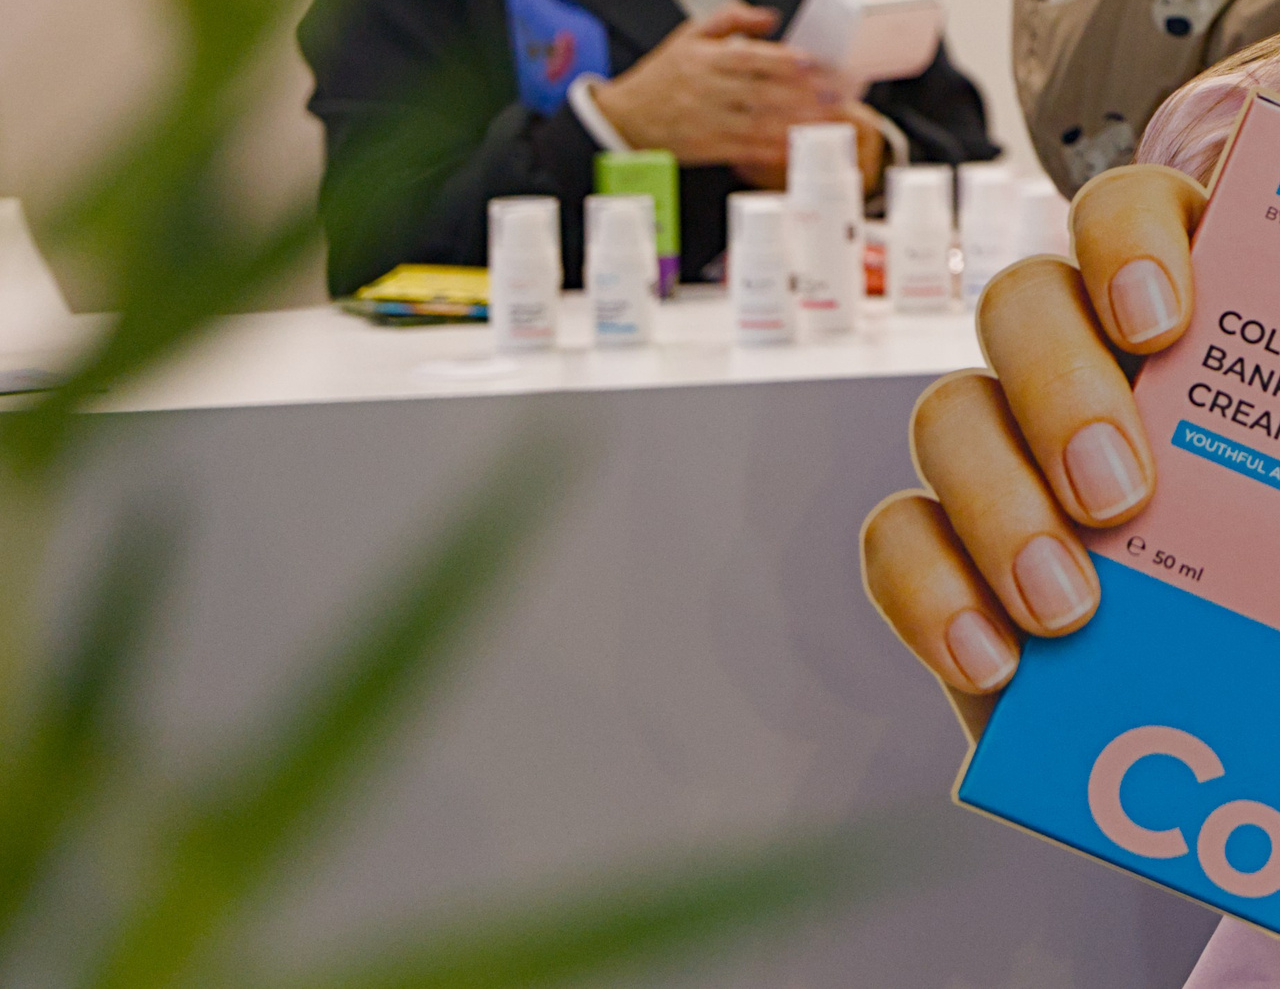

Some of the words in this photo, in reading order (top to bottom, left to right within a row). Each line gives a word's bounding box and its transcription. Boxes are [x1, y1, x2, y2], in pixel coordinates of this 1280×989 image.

[1184, 428, 1266, 475] YOUTHFUL
[1152, 550, 1176, 571] 50
[1178, 563, 1205, 582] ml
